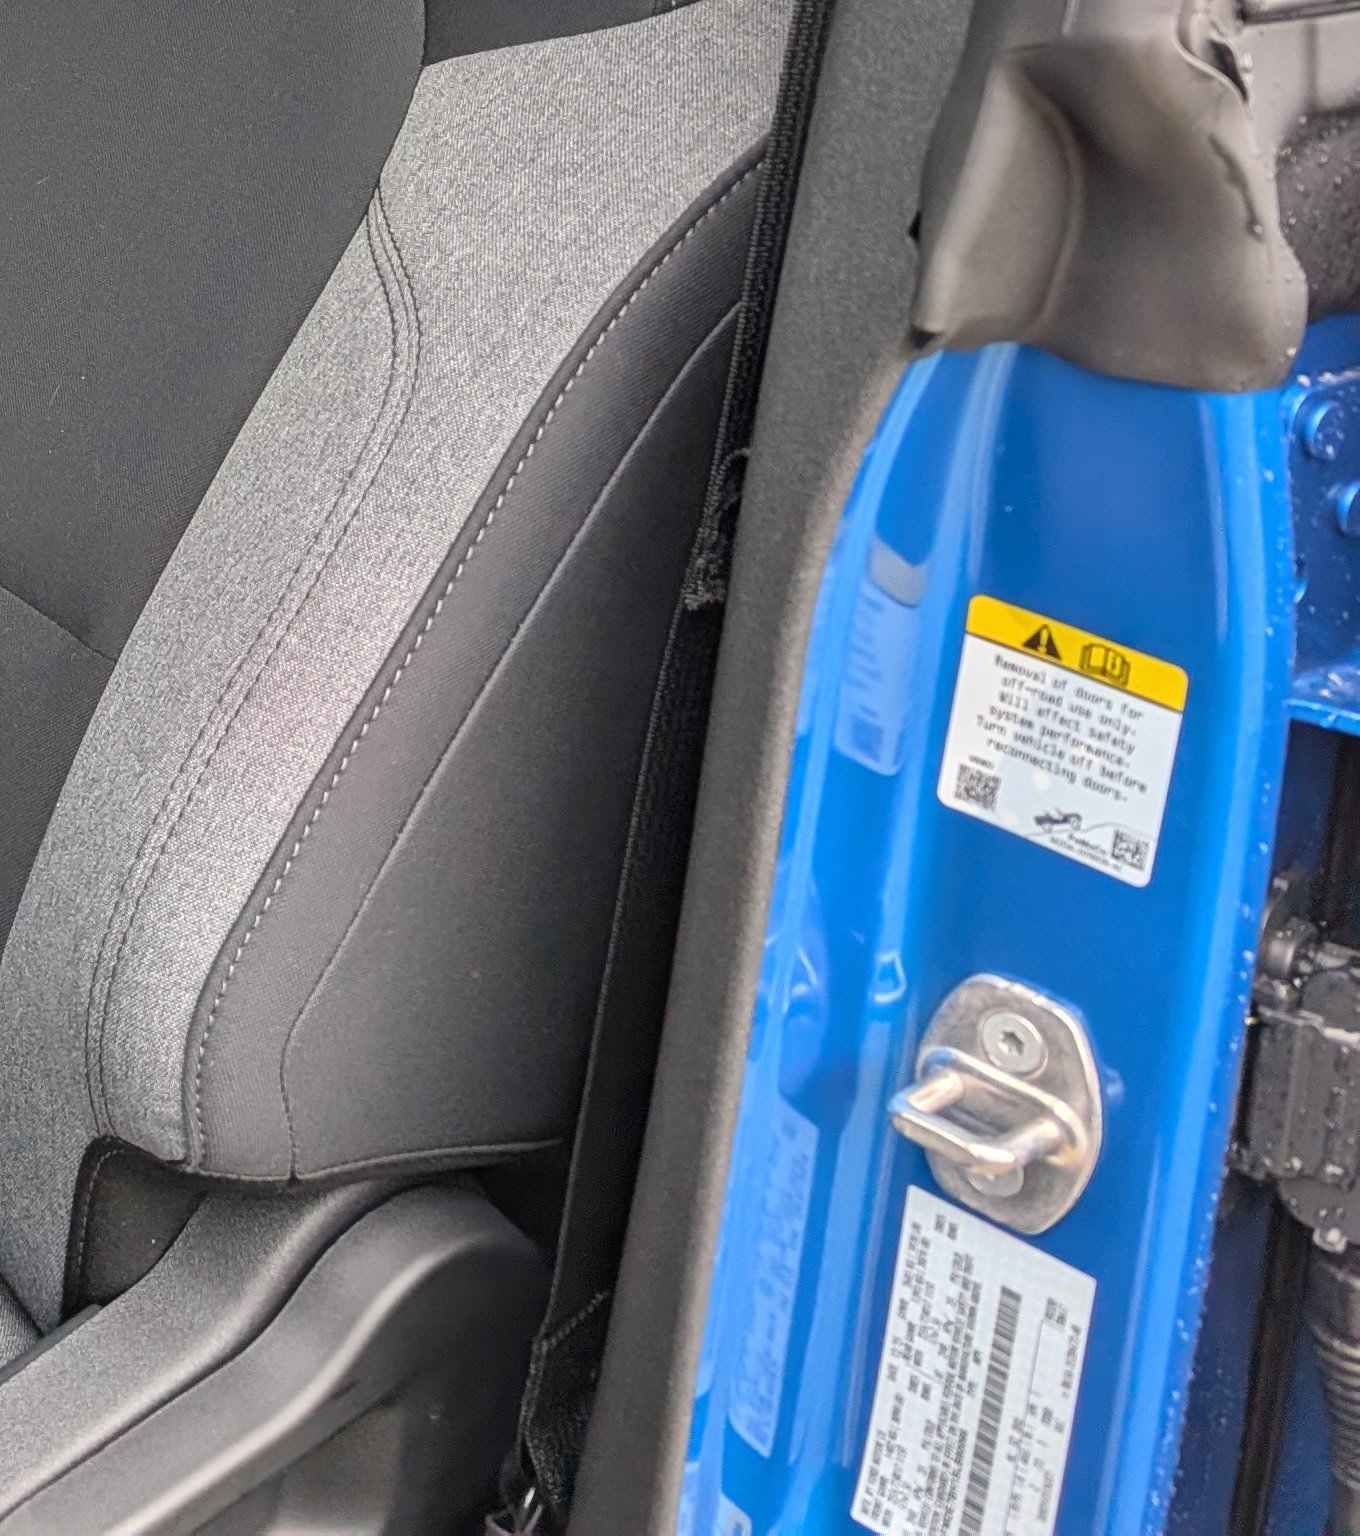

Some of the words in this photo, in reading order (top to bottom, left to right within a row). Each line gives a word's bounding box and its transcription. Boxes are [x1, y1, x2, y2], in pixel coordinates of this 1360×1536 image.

[994, 654, 1047, 685] Removal
[1051, 677, 1069, 691] of
[1074, 686, 1114, 711] doors
[1120, 702, 1144, 720] for
[1000, 676, 1064, 708] off-road
[1068, 702, 1093, 719] use
[988, 705, 1035, 731] system
[998, 689, 1029, 712] Will
[1036, 707, 1081, 733] affect
[1088, 726, 1136, 756] safety
[976, 714, 1007, 736] Turn
[1012, 731, 1066, 761] vehicle
[1069, 754, 1094, 771] off
[1099, 765, 1148, 794] before
[986, 737, 1077, 785] reconnecting
